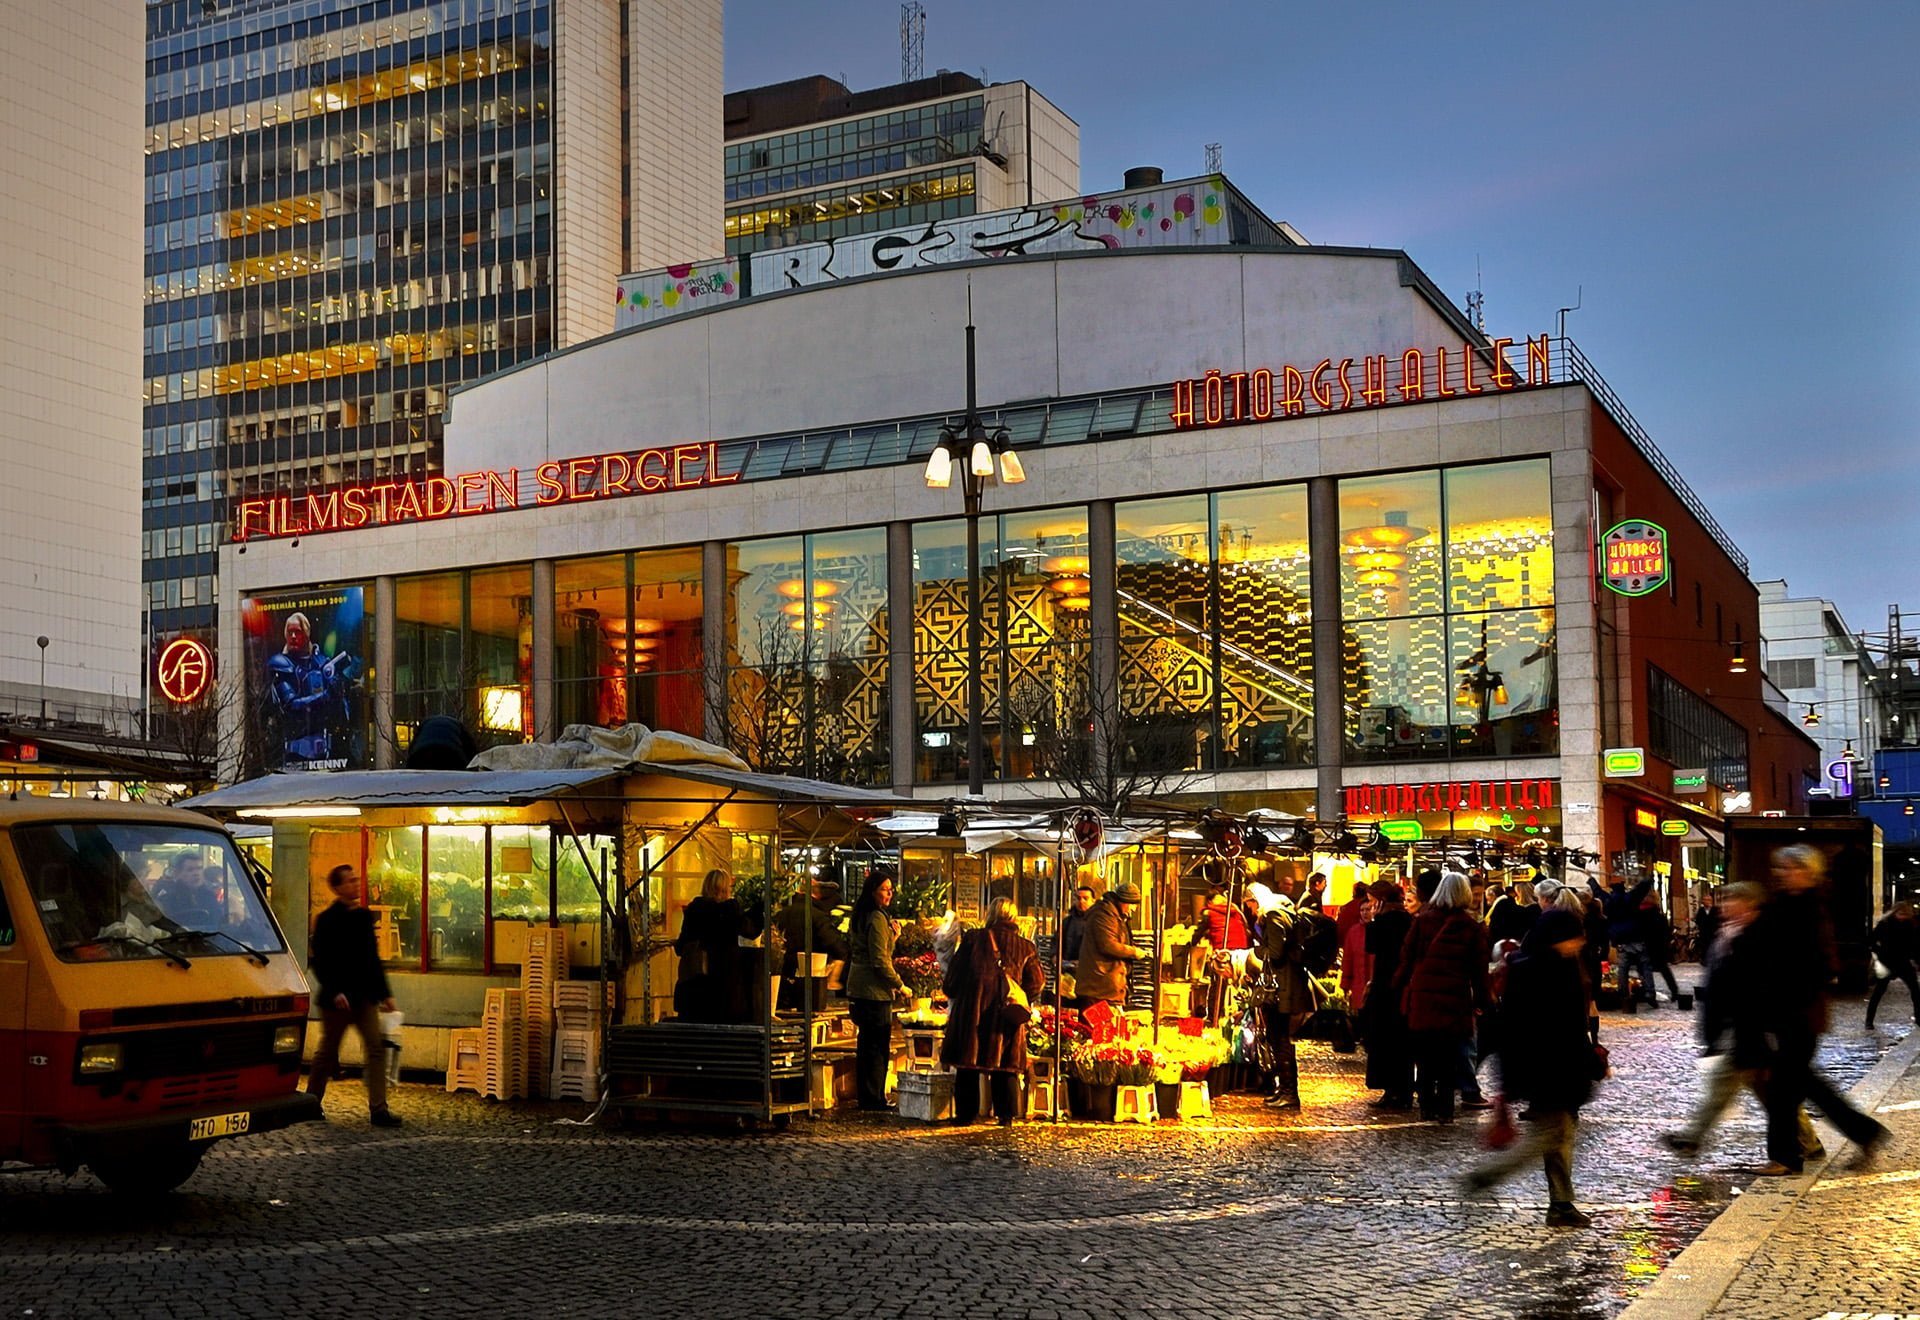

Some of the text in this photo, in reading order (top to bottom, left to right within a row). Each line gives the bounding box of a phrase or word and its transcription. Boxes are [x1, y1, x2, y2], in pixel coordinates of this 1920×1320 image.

[1170, 333, 1550, 427] HÖTORGSHALLEN
[236, 443, 740, 540] FILMSTADEN SERGEL
[1609, 541, 1661, 558] HÖTORGS
[1611, 558, 1661, 575] HALLEN
[162, 647, 202, 697] SF
[309, 758, 348, 770] KENNY
[1346, 780, 1552, 815] HÖTORGSHALLEN
[190, 1113, 248, 1138] MTO 156
